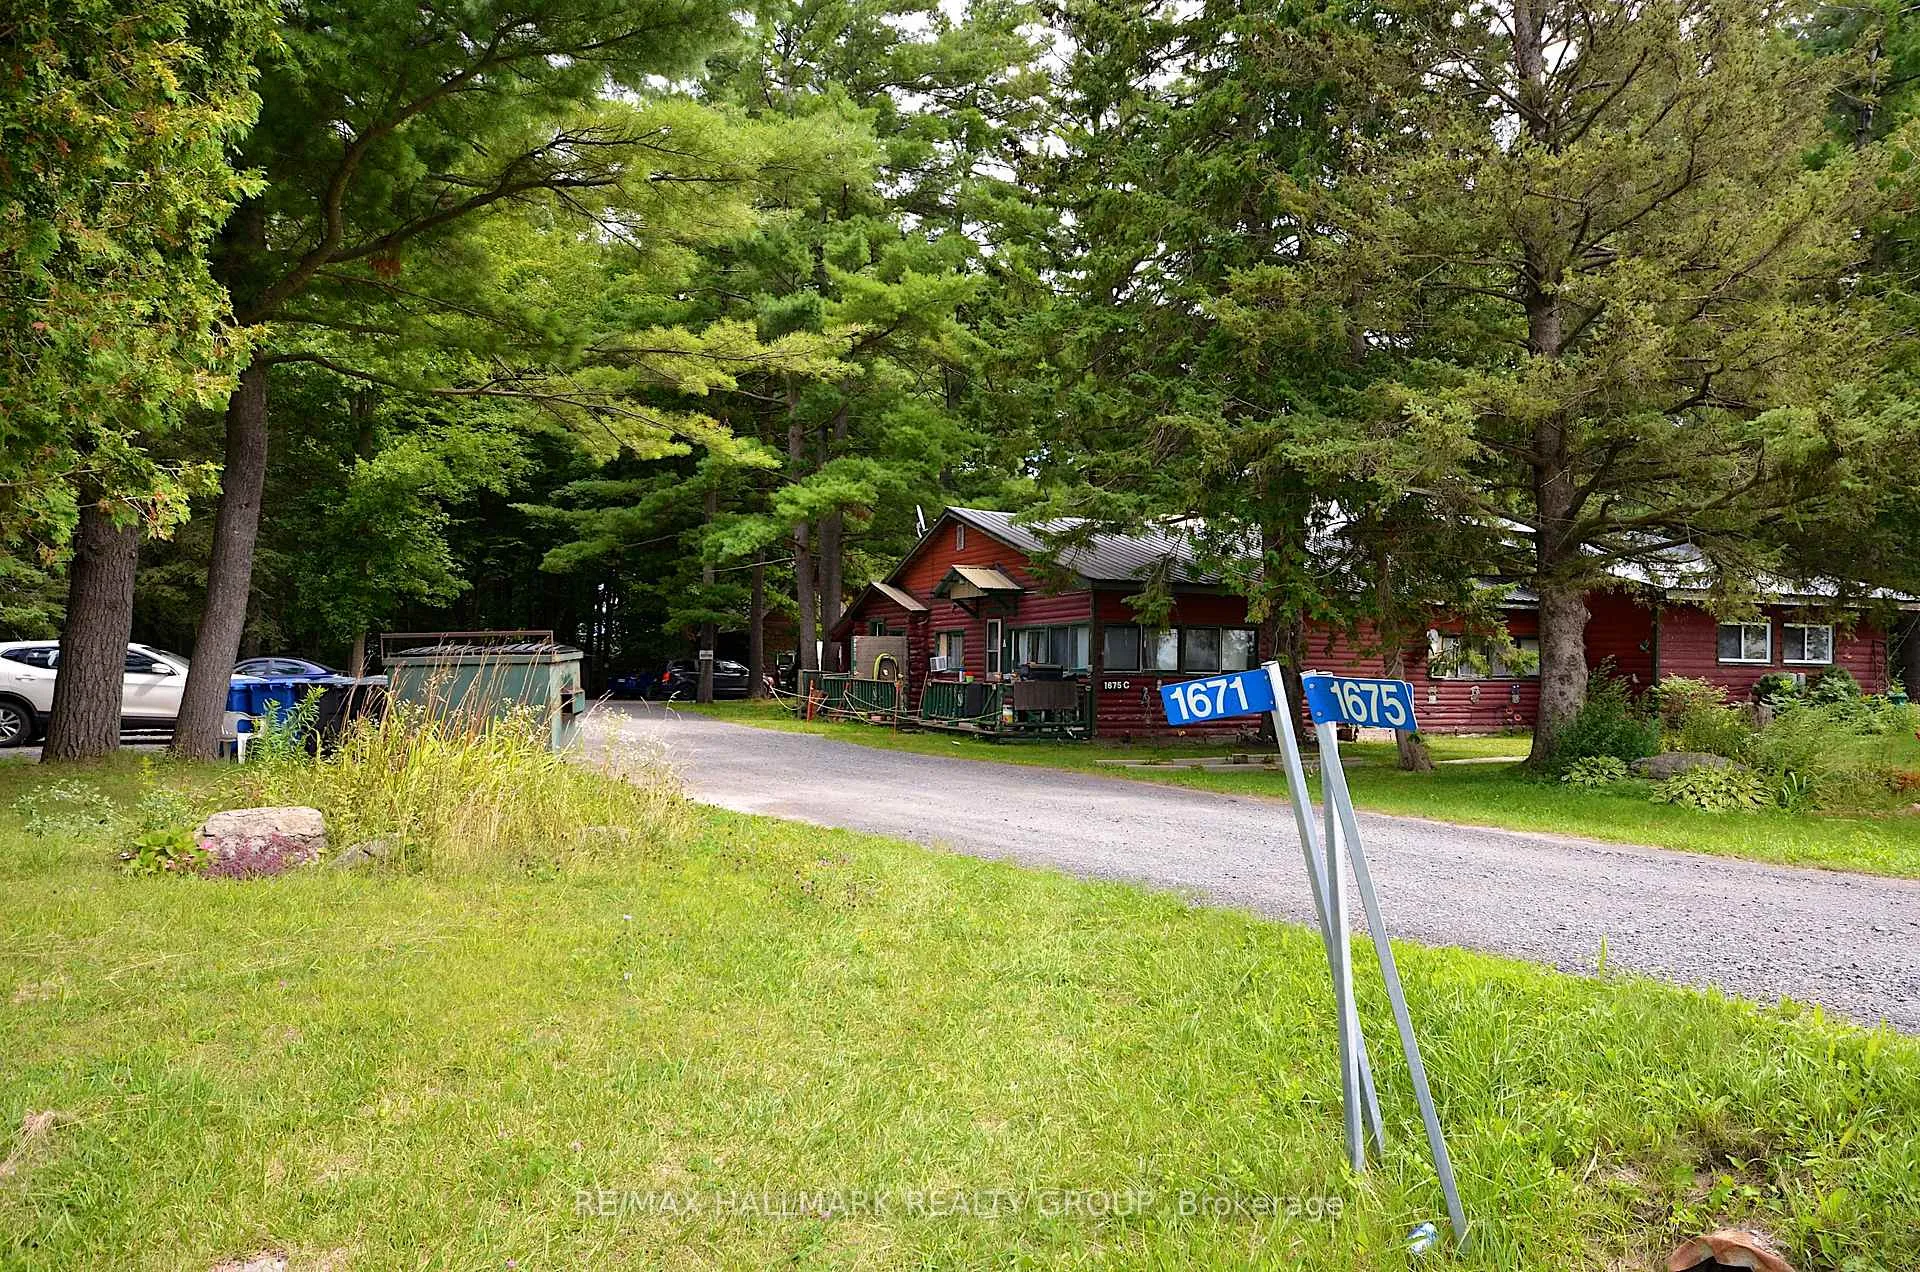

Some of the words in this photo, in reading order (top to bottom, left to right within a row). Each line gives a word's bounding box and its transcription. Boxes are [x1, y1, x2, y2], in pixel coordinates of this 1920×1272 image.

[1104, 681, 1122, 690] 1675
[1123, 681, 1130, 689] C
[1170, 676, 1249, 721] 1671
[1330, 680, 1406, 726] 1675
